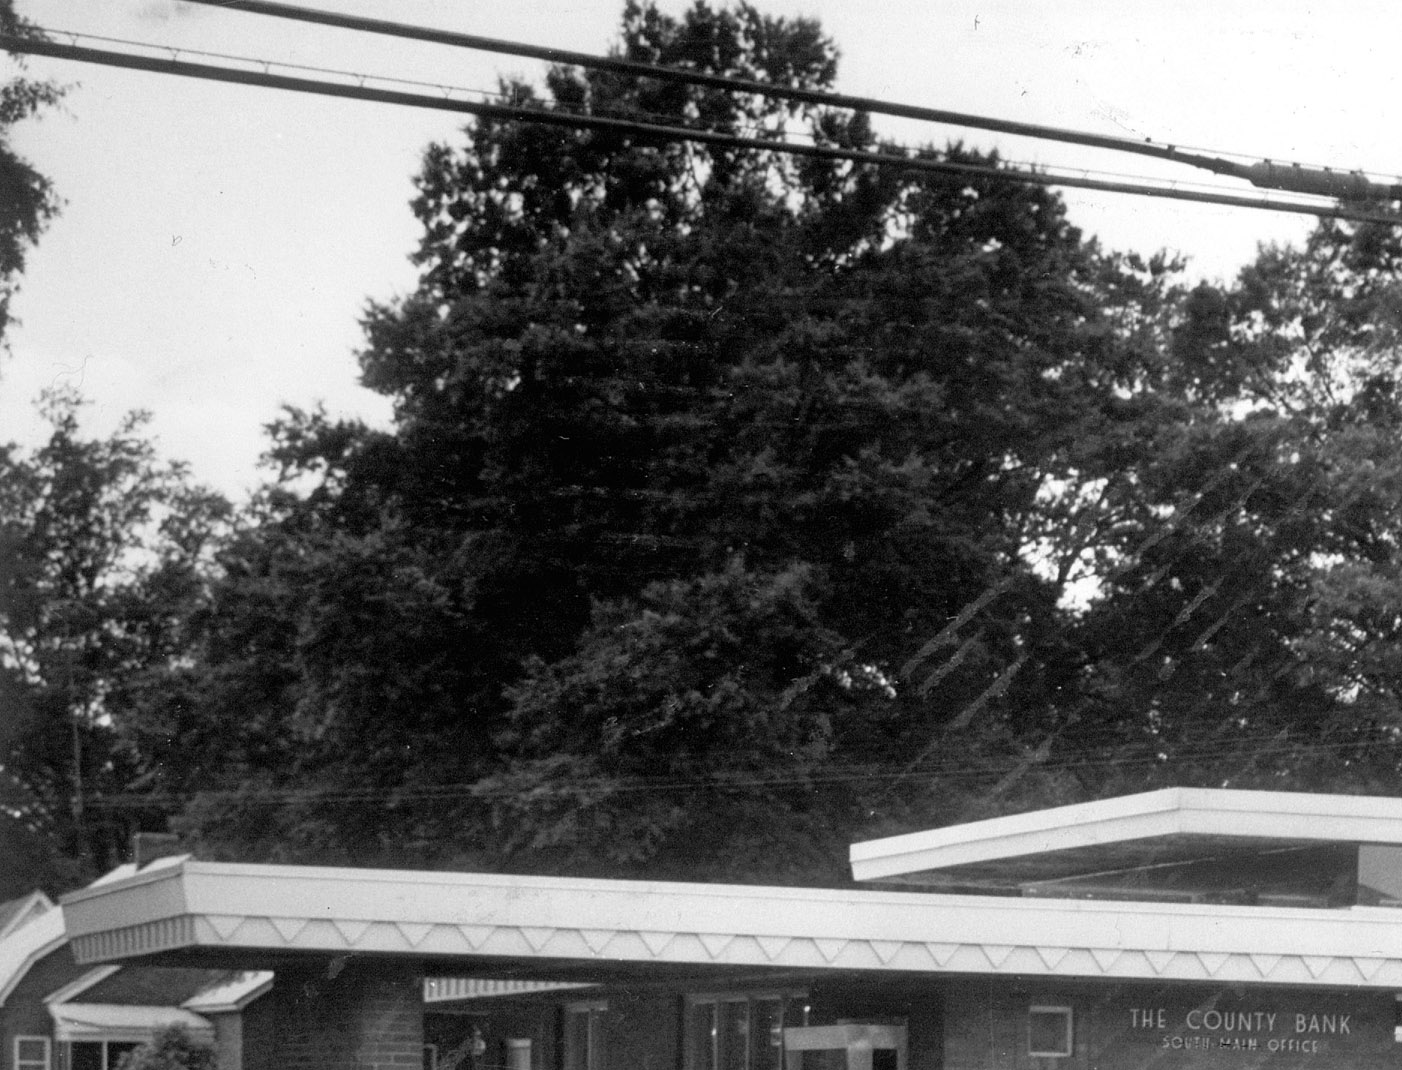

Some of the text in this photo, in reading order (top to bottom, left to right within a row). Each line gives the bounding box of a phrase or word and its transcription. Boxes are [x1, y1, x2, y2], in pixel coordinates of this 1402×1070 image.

[1130, 1008, 1351, 1035] THE COUNTY BANK
[1162, 1035, 1319, 1054] SOUTH MAIN OFFICE
